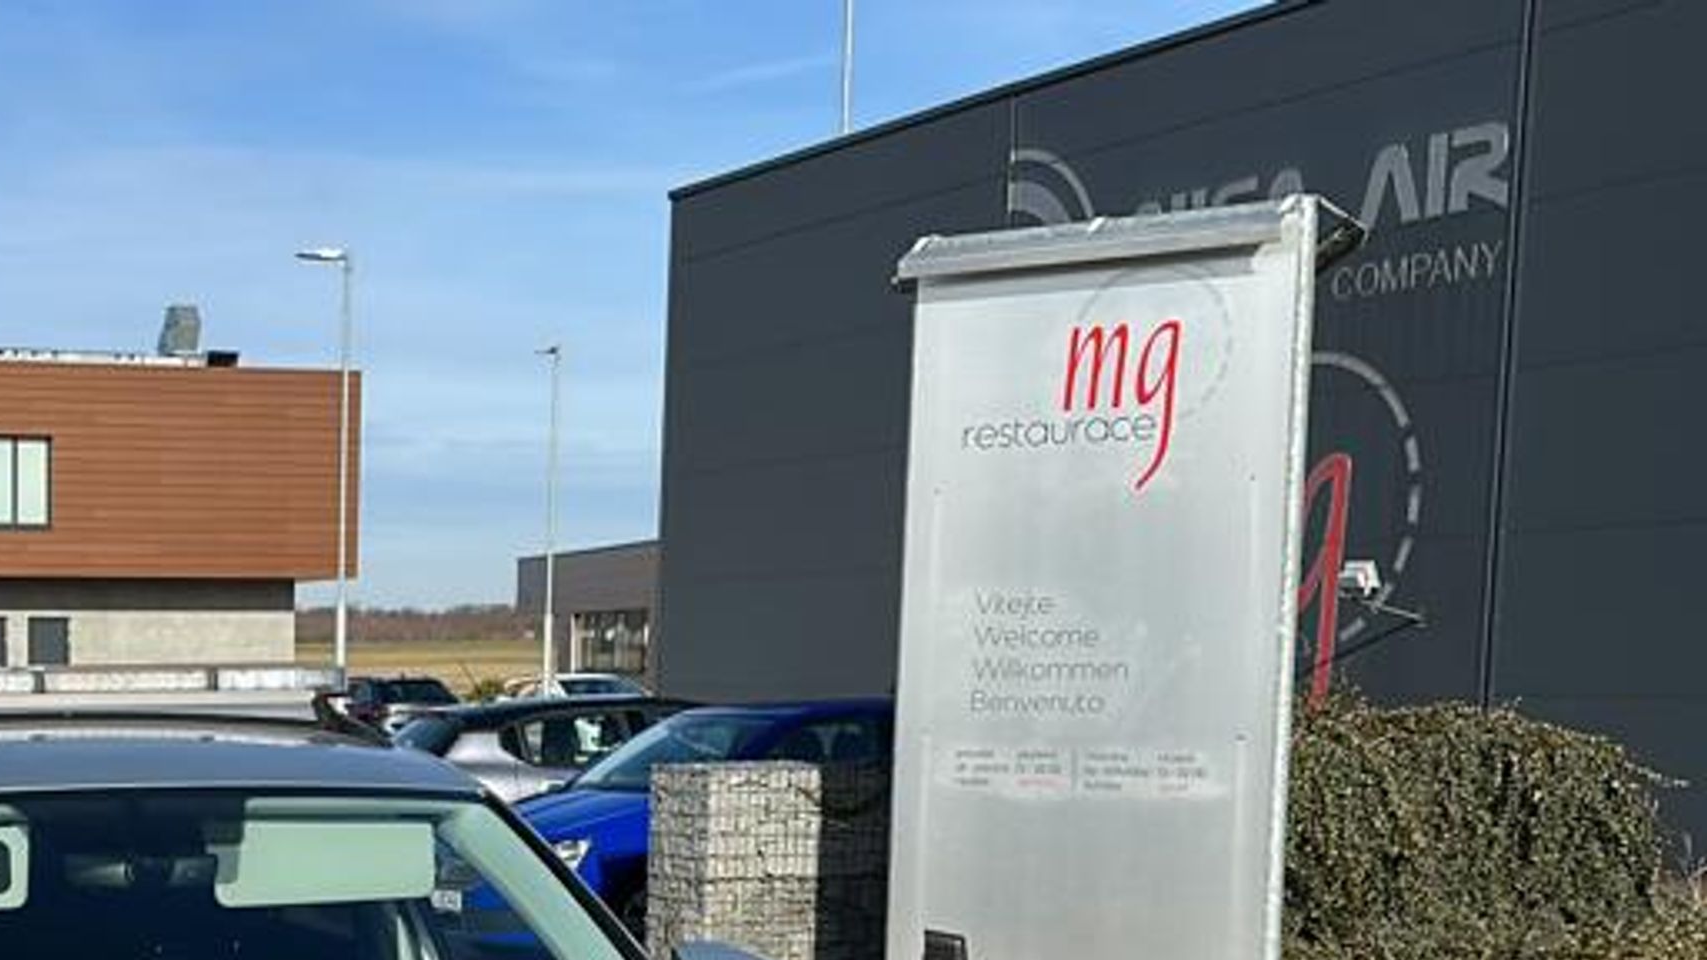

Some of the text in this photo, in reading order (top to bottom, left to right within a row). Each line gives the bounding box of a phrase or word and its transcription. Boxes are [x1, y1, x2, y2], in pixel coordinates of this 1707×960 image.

[1360, 122, 1509, 230] AIR
[1330, 242, 1504, 299] COMPANY
[961, 412, 1155, 450] restaurace
[1064, 320, 1181, 489] mg
[974, 625, 1099, 648] Welcome
